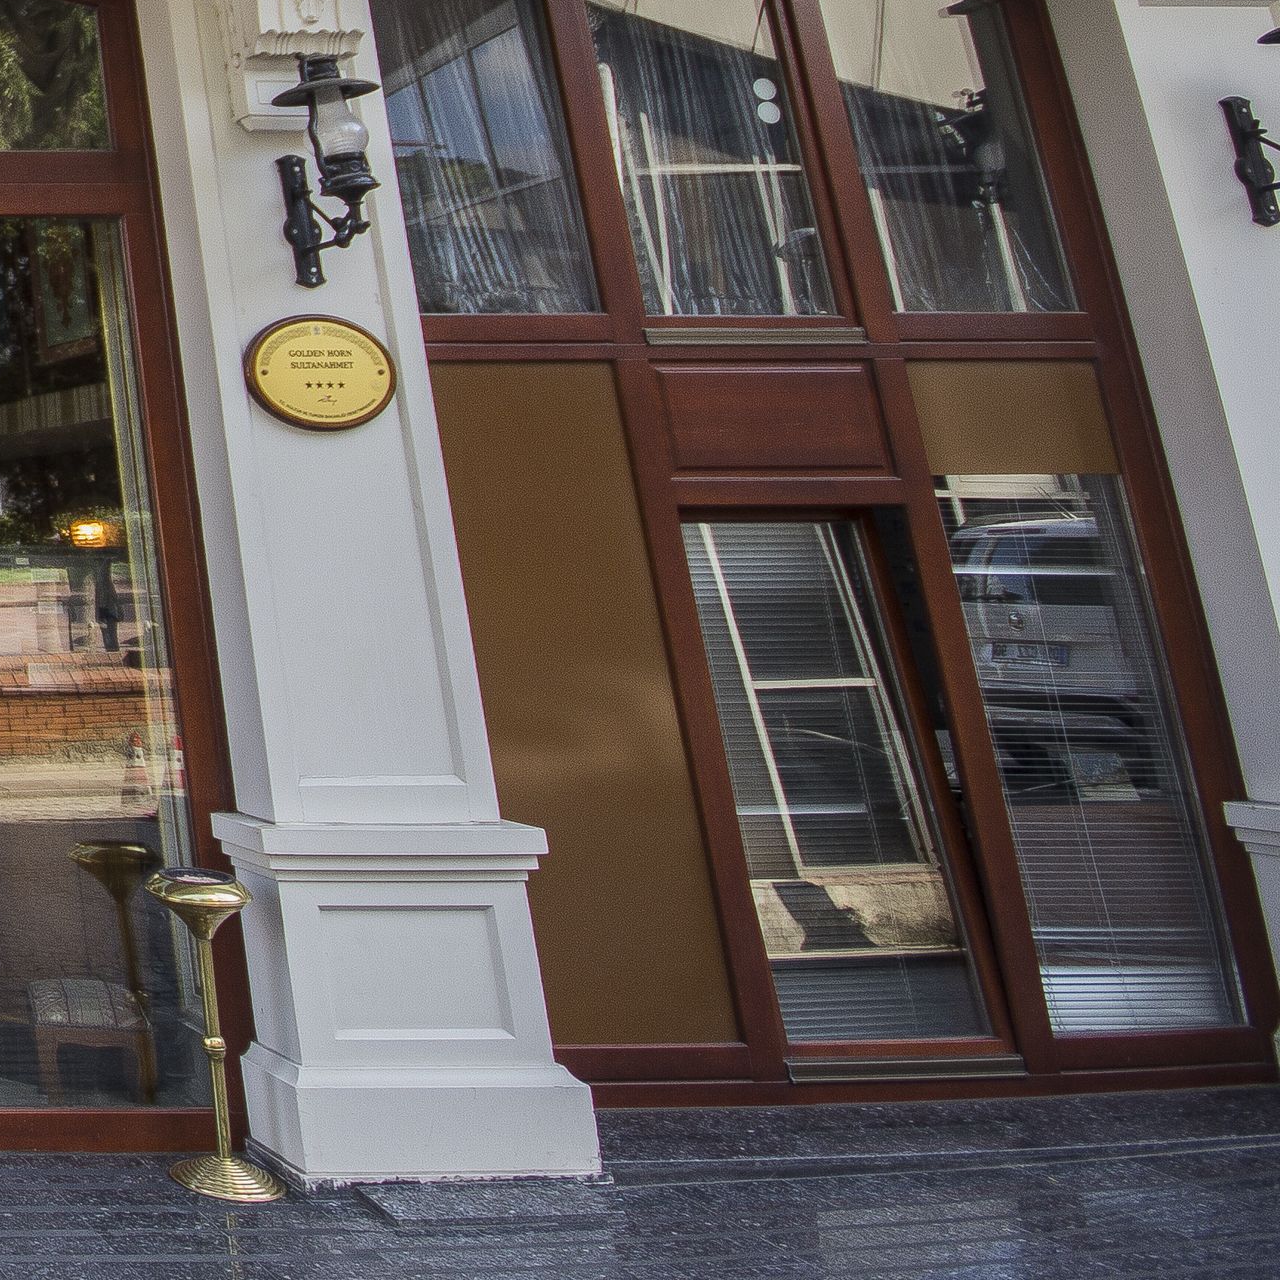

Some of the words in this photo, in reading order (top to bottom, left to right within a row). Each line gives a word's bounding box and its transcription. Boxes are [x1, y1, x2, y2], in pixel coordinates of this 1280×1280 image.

[288, 349, 325, 358] GOLDEN
[327, 349, 352, 358] HORN
[290, 361, 354, 369] SULTANAHMET
